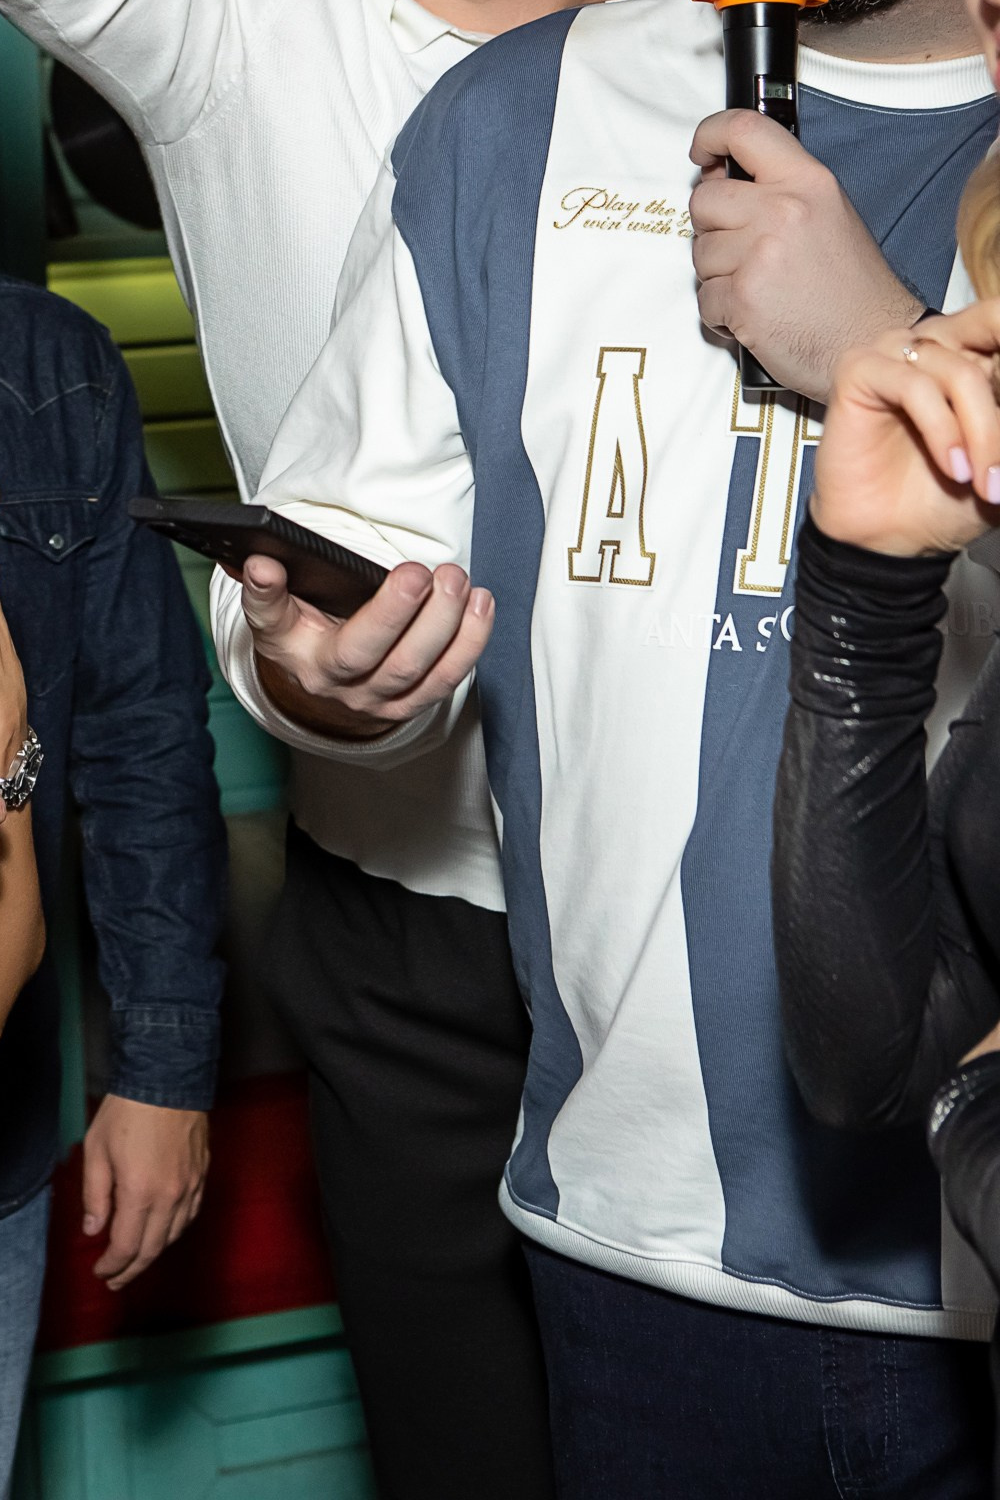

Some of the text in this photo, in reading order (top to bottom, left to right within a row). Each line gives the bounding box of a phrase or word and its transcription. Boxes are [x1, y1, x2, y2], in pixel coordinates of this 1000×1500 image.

[553, 187, 640, 229] Play
[644, 199, 676, 217] the
[583, 216, 622, 231] win
[627, 218, 673, 236] with
